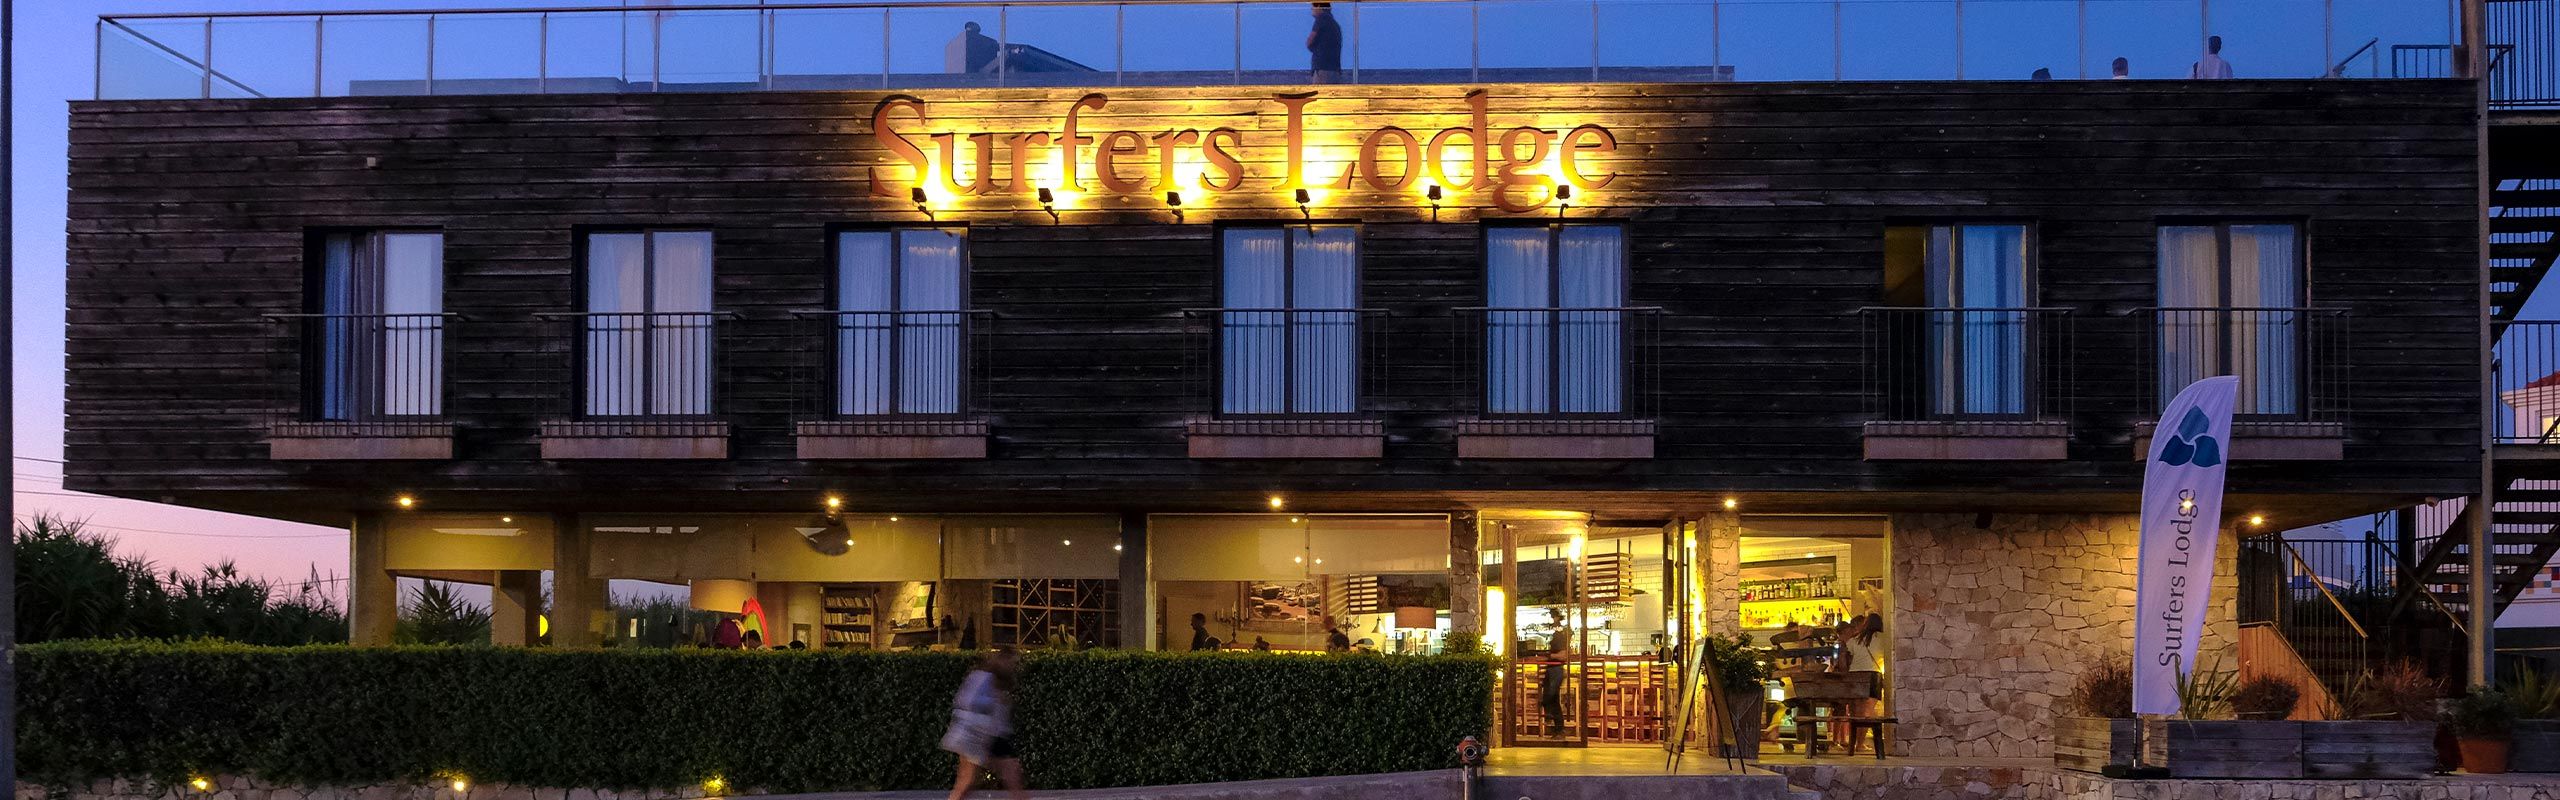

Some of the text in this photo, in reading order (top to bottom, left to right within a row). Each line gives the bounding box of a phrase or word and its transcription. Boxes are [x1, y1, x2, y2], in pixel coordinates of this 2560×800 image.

[869, 89, 1617, 213] Surfers Lodge
[2159, 488, 2198, 668] Surfers Lodge
